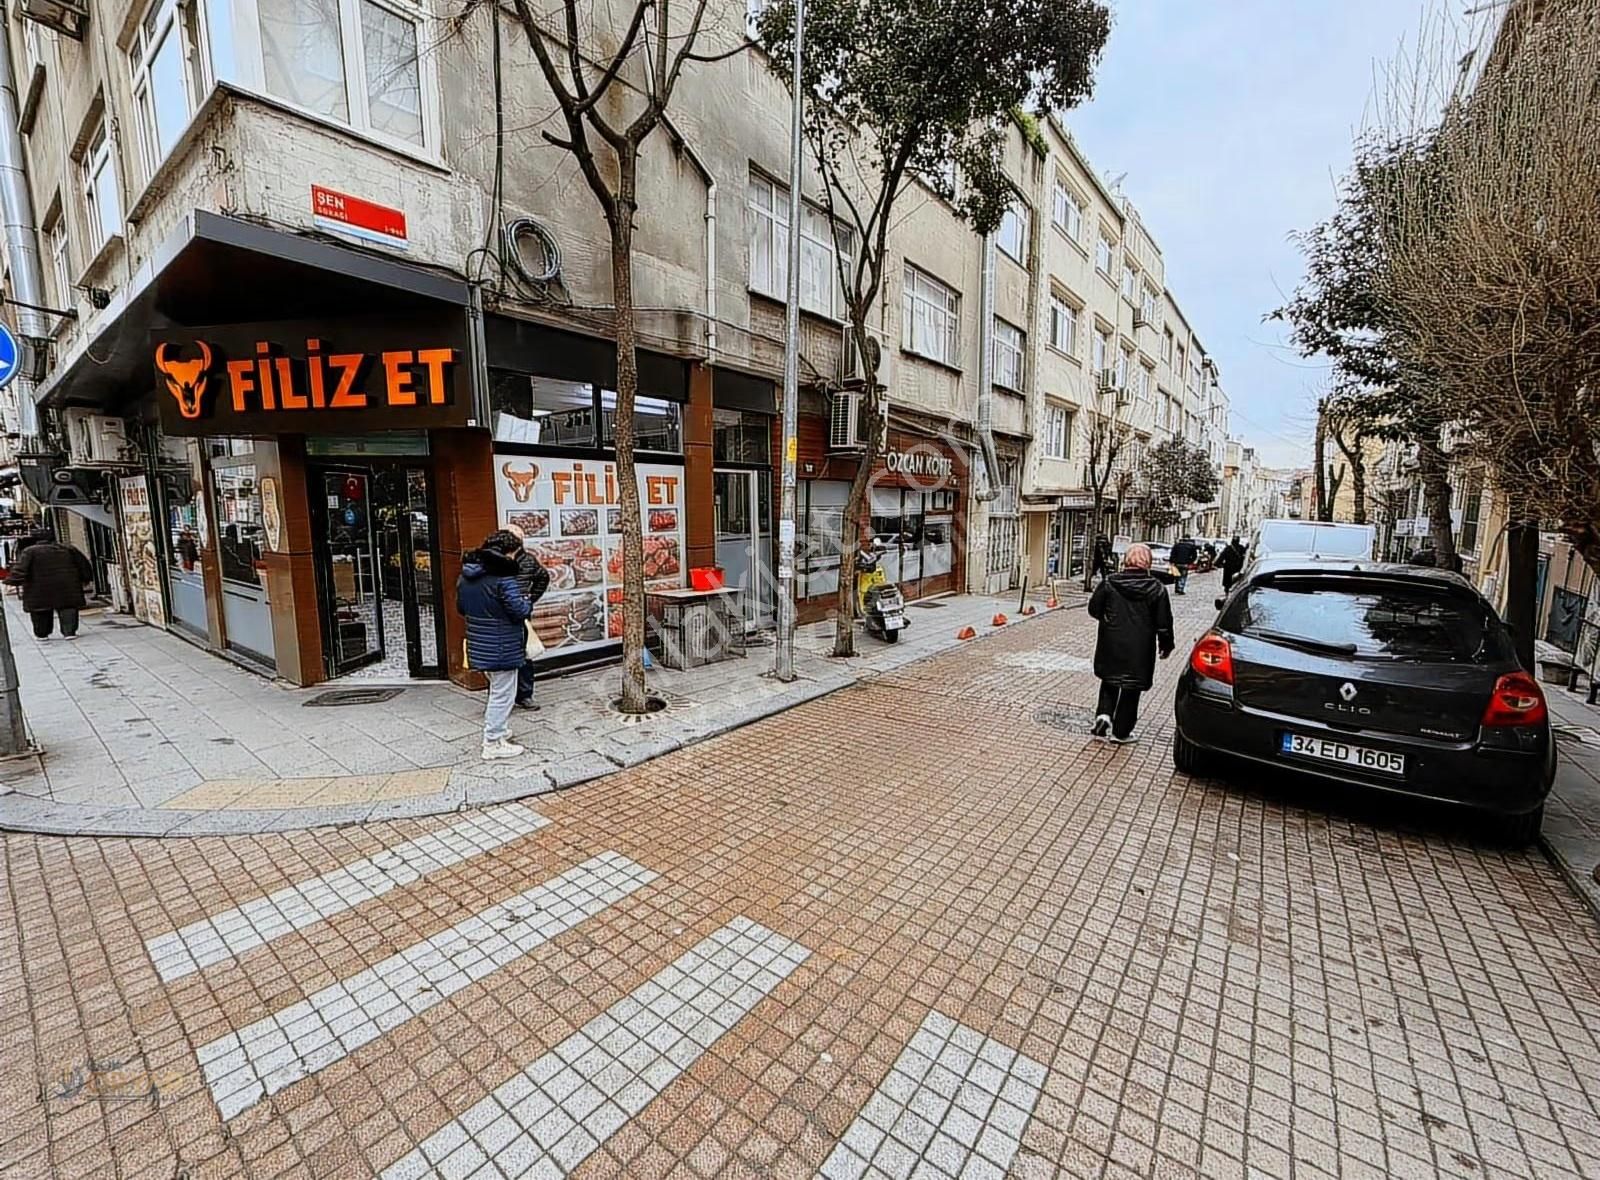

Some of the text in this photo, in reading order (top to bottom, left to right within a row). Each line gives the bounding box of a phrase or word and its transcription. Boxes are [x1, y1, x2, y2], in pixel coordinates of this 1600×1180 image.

[227, 338, 453, 412] FİLİZ ET
[887, 446, 952, 476] ÖZCAN KÖFTE
[552, 463, 678, 505] FİLİ ET
[1324, 702, 1371, 715] CLIO
[1292, 736, 1315, 754] 34
[1321, 741, 1349, 760] ED
[1355, 749, 1404, 771] 1605
